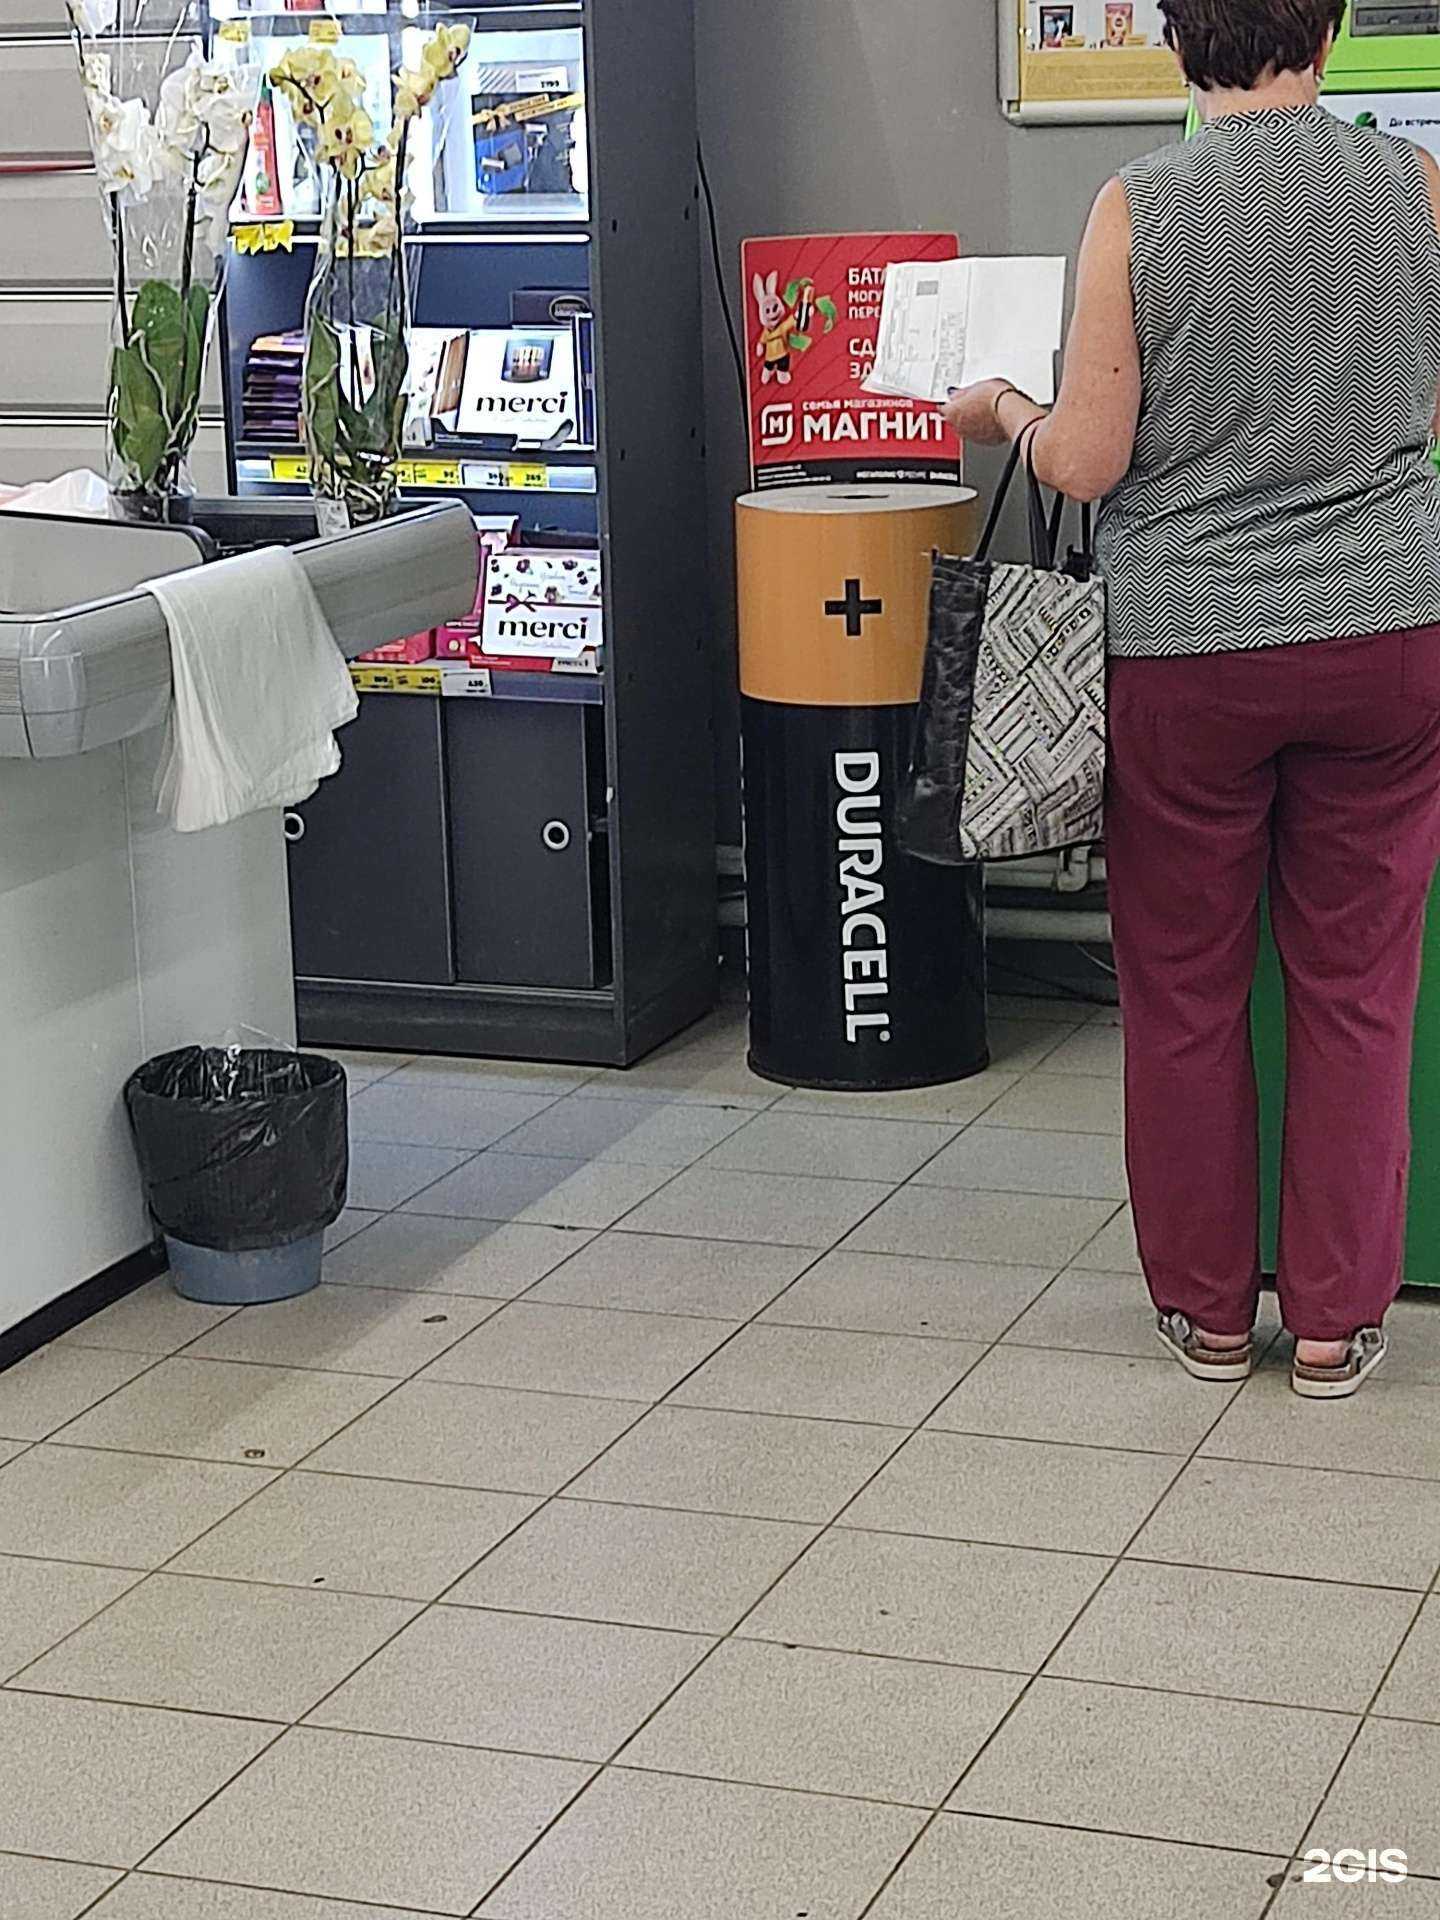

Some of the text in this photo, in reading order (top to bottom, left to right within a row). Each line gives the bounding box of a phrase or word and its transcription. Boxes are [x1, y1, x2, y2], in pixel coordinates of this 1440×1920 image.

[476, 391, 568, 413] merci
[803, 411, 946, 443] МАГНИТ
[498, 617, 588, 639] merci
[835, 751, 890, 1043] DURACELL
